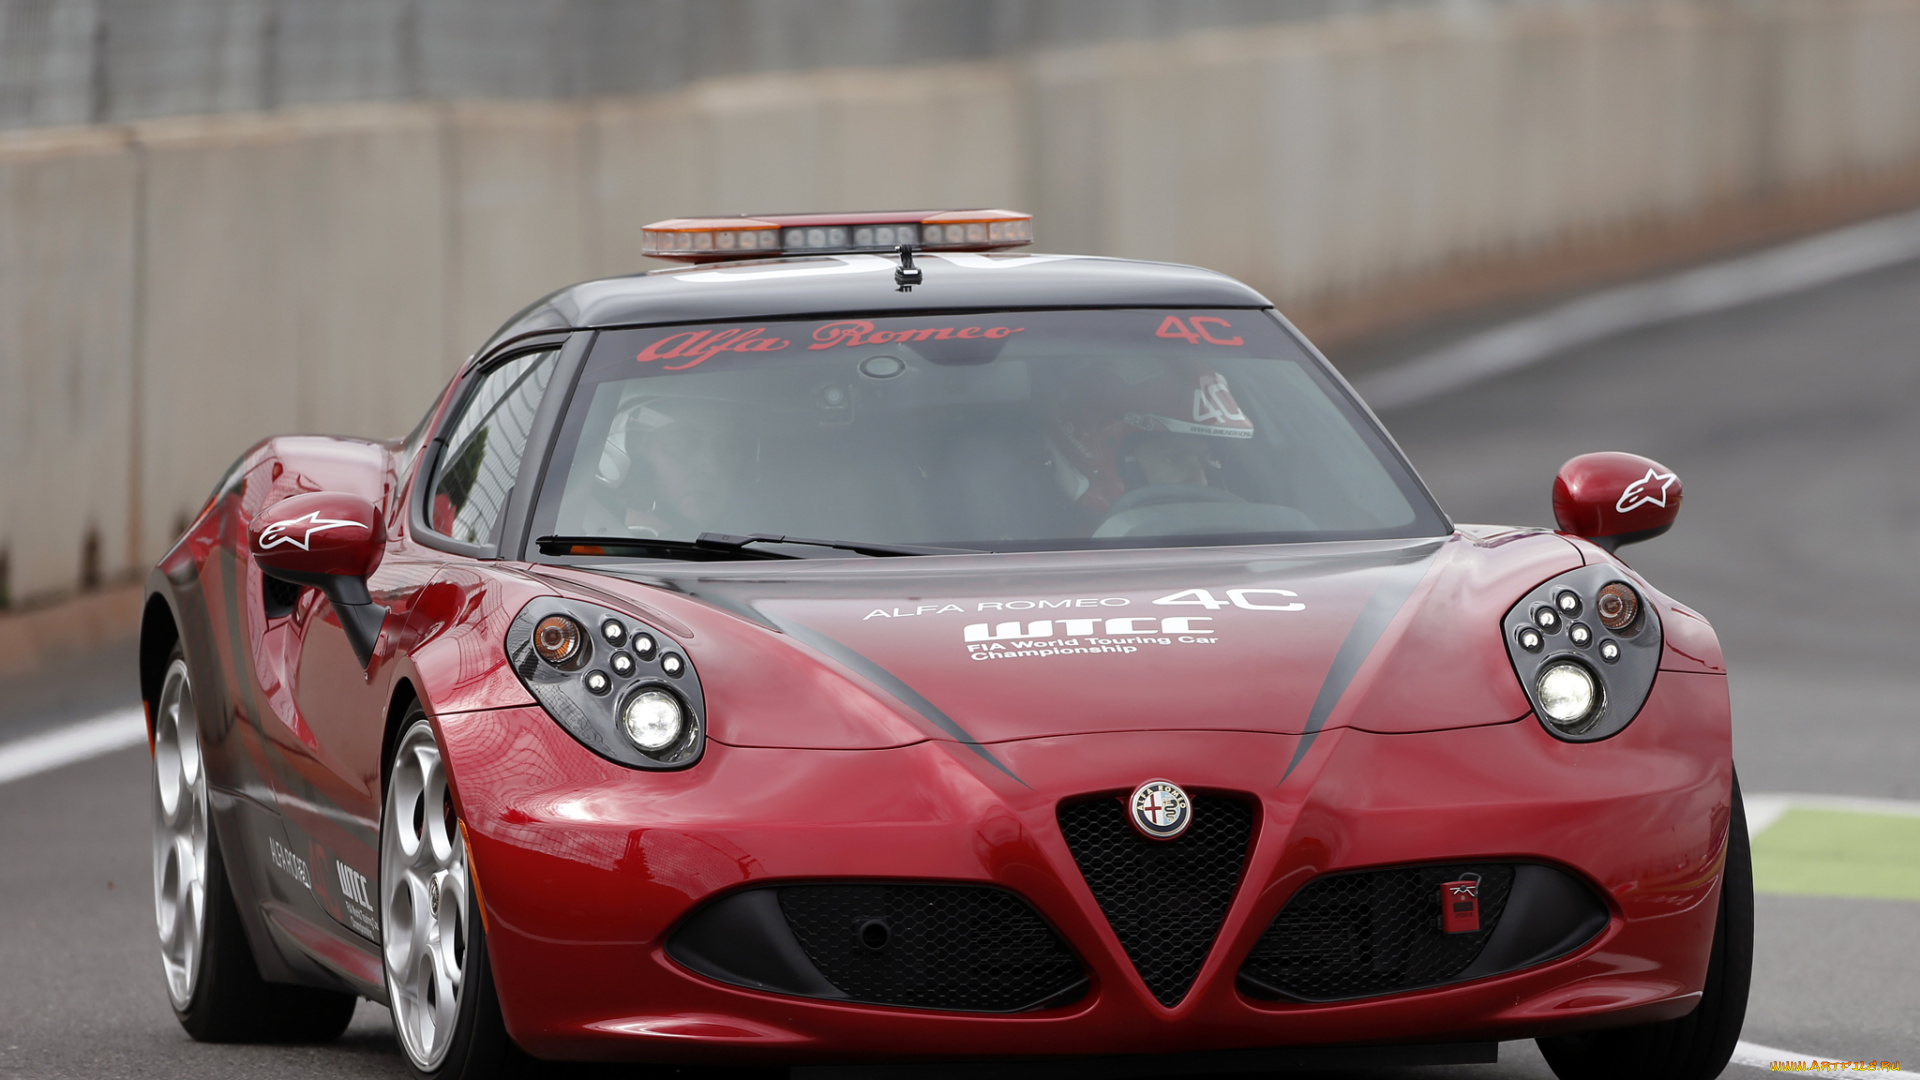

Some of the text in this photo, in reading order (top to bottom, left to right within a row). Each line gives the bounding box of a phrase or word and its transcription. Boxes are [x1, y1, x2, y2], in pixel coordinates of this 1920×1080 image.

[636, 320, 1025, 370] Alfa Romeo
[1155, 315, 1245, 346] 4C
[1193, 383, 1245, 423] 4C
[863, 588, 1306, 621] ALFA ROMEO 4C
[963, 616, 1214, 642] WTCC
[967, 635, 1218, 652] FIA World Touring Car
[970, 644, 1138, 661] Championship
[1136, 785, 1186, 811] ALFA ROMEO
[336, 859, 373, 912] WTCC
